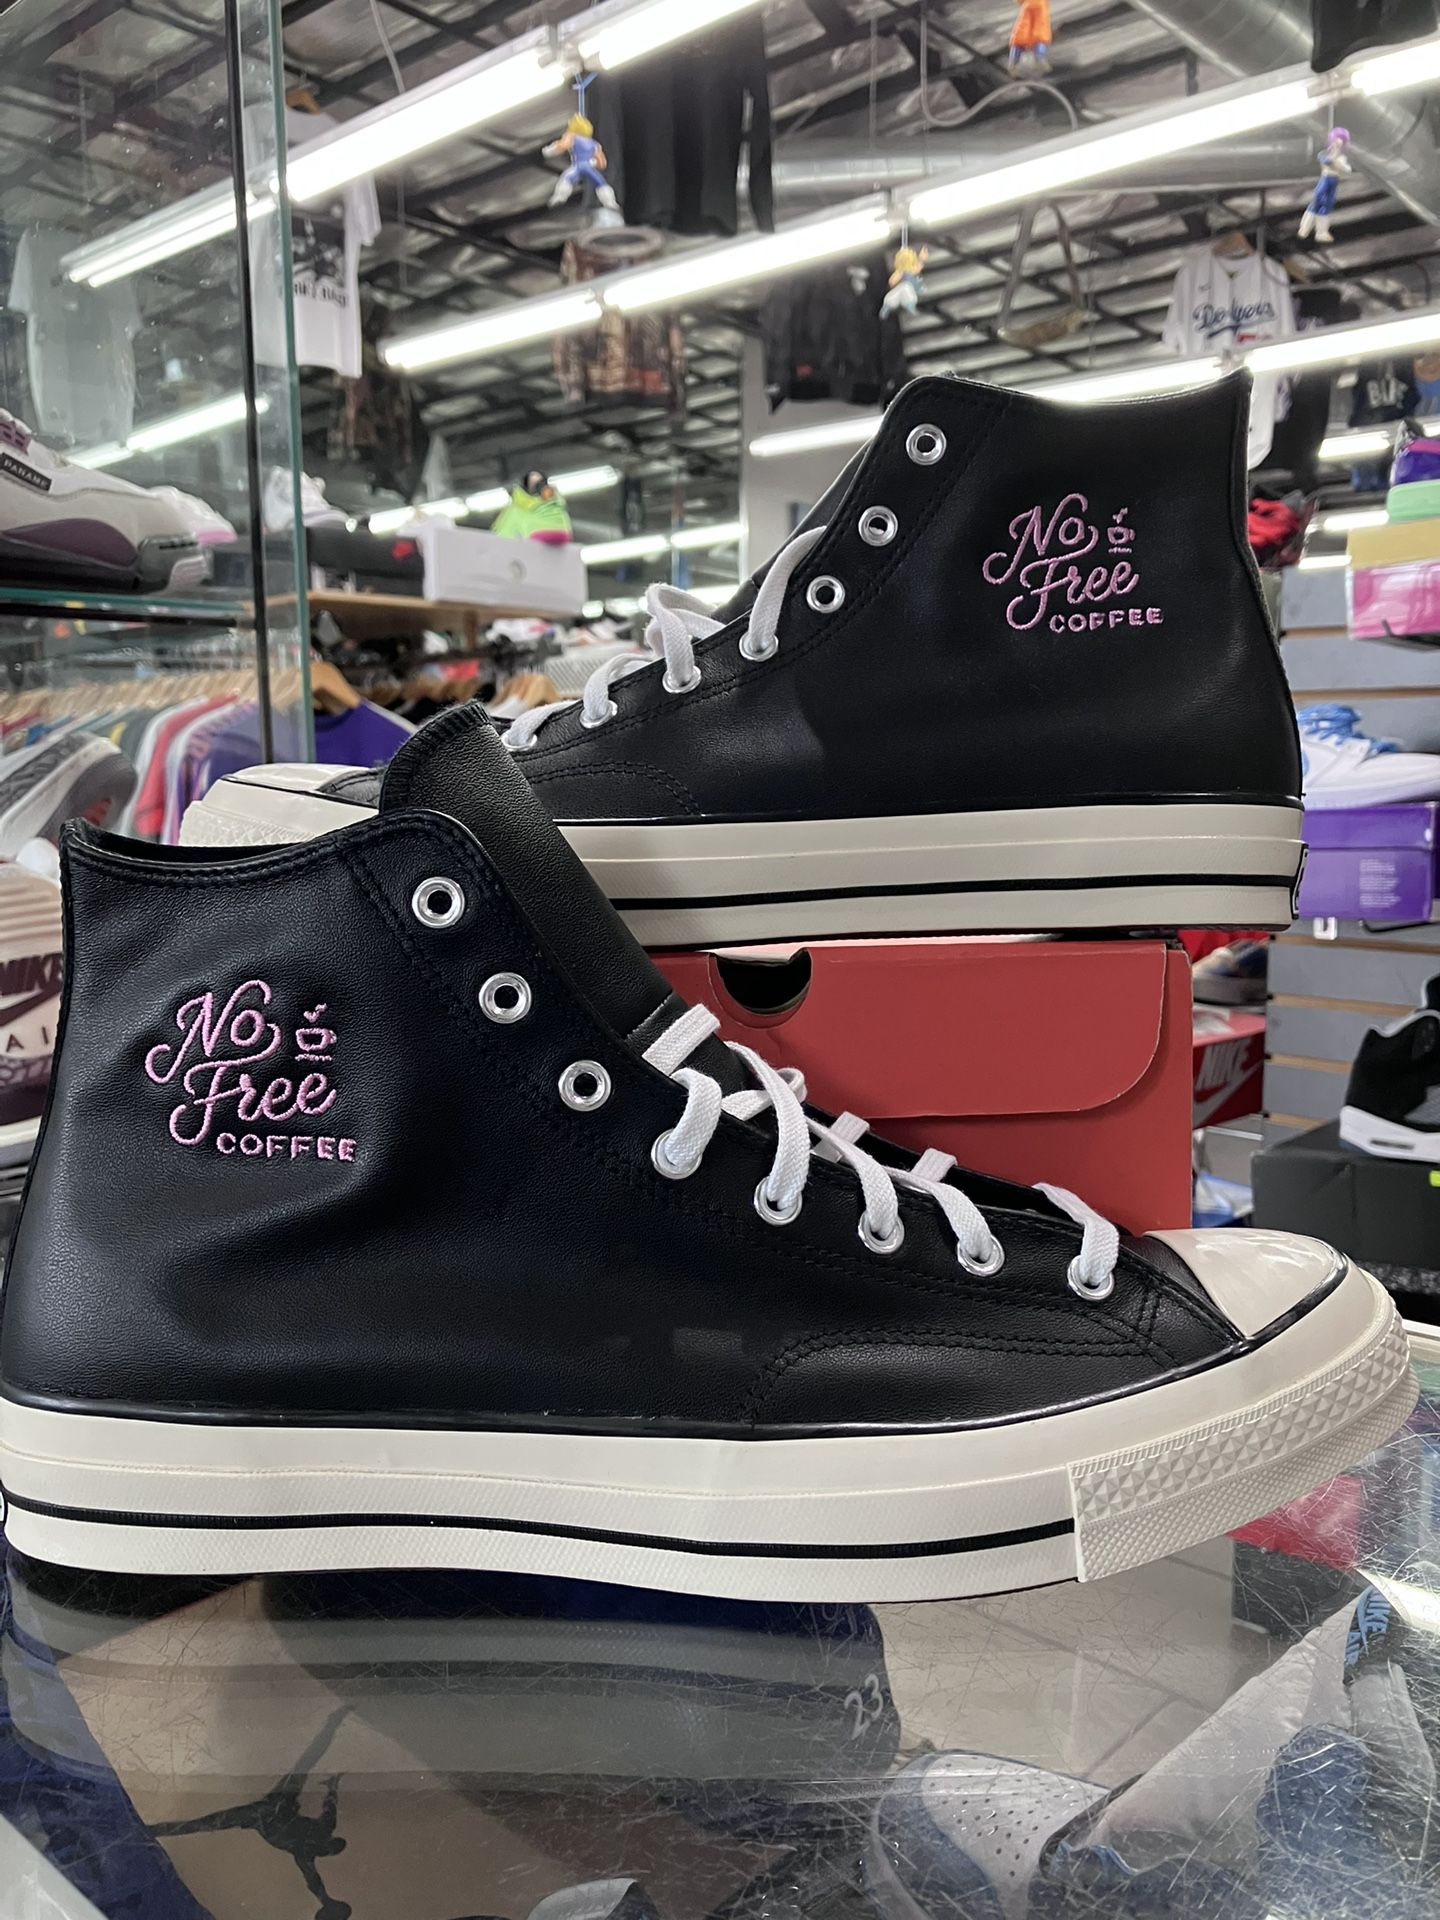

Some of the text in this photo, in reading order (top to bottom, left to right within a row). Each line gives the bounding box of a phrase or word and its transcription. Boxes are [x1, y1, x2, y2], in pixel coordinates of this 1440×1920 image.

[983, 493, 1092, 584] No
[1006, 548, 1139, 630] Free
[1050, 607, 1163, 633] COFFEE
[145, 980, 277, 1084] No
[169, 1048, 337, 1146] Free
[216, 1132, 356, 1162] COFFEE
[843, 1673, 884, 1740] 23
